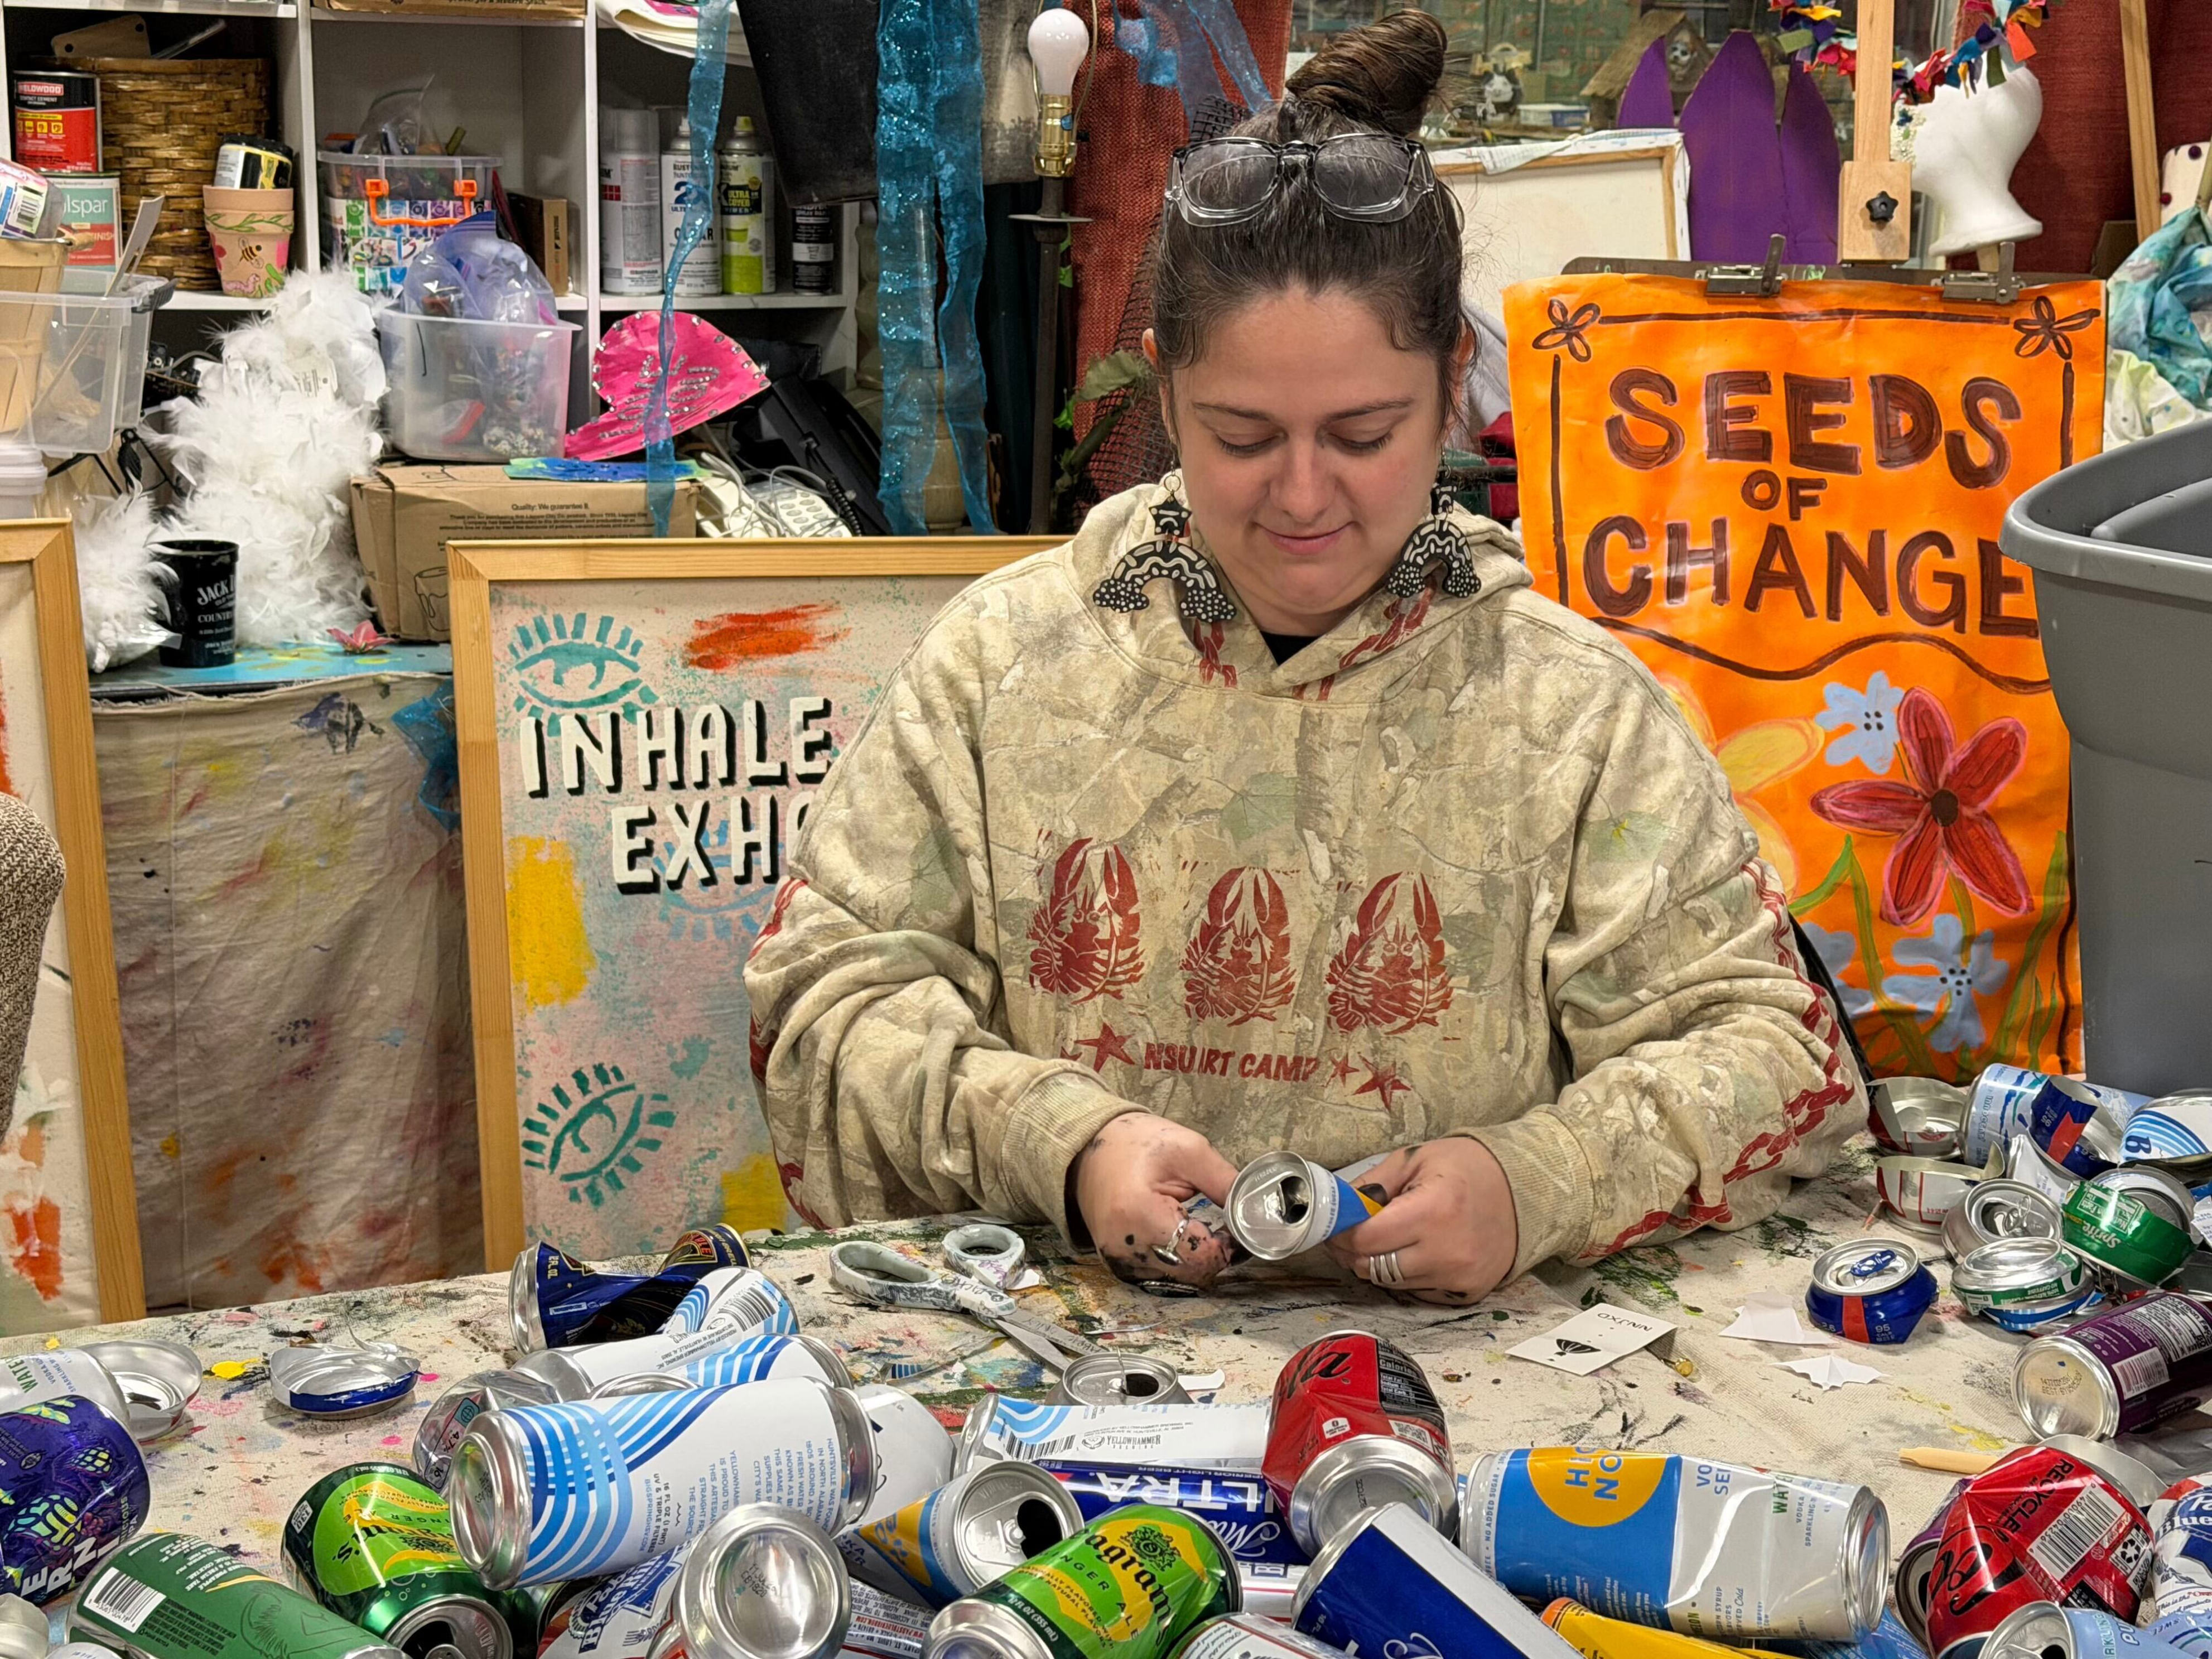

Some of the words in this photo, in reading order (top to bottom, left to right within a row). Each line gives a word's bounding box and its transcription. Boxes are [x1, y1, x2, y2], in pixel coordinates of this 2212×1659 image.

[64, 195, 108, 218] lspar
[1604, 366, 2022, 490] SEEDS
[1741, 470, 1827, 521] OF
[1583, 515, 2039, 639] CHANGE
[197, 579, 229, 606] JACK
[519, 696, 833, 799] INHALE
[1237, 1053, 1320, 1083] CAMP
[2082, 1220, 2122, 1249] Sprite
[1875, 1323, 1891, 1333] 95
[816, 1447, 825, 1458] IN
[1106, 1433, 1162, 1447] YELLOWHAMMER
[719, 1457, 727, 1467] IS
[773, 1448, 783, 1468] THIS
[783, 1449, 794, 1483] KNOWN
[795, 1450, 806, 1479] FRESH
[826, 1438, 838, 1487] HUNTSVILLE
[652, 1473, 661, 1484] UV
[707, 1463, 718, 1483] THIS
[720, 1468, 730, 1498] PROUD
[763, 1455, 773, 1494] SUPPLIES
[775, 1468, 784, 1493] SAME
[807, 1460, 816, 1497] AROUND
[817, 1459, 827, 1488] NORTH
[1489, 1473, 1500, 1498] SUGAR
[662, 1482, 671, 1492] 16
[663, 1493, 672, 1504] FL
[688, 1486, 697, 1503] THE
[698, 1477, 707, 1518] STRAIGHT
[786, 1484, 795, 1497] AS
[828, 1487, 837, 1506] WAS
[2002, 1458, 2075, 1534] RECYCLE
[391, 1512, 450, 1524] INGER
[663, 1506, 672, 1518] OZ
[685, 1504, 696, 1536] SOURCE
[1486, 1498, 1495, 1530] ADDED
[648, 1525, 661, 1554] FILTERED
[658, 1527, 669, 1546] PINT)
[1484, 1531, 1492, 1542] NO
[1714, 1586, 1723, 1613] SYRUP
[1735, 1587, 1744, 1607] Cold
